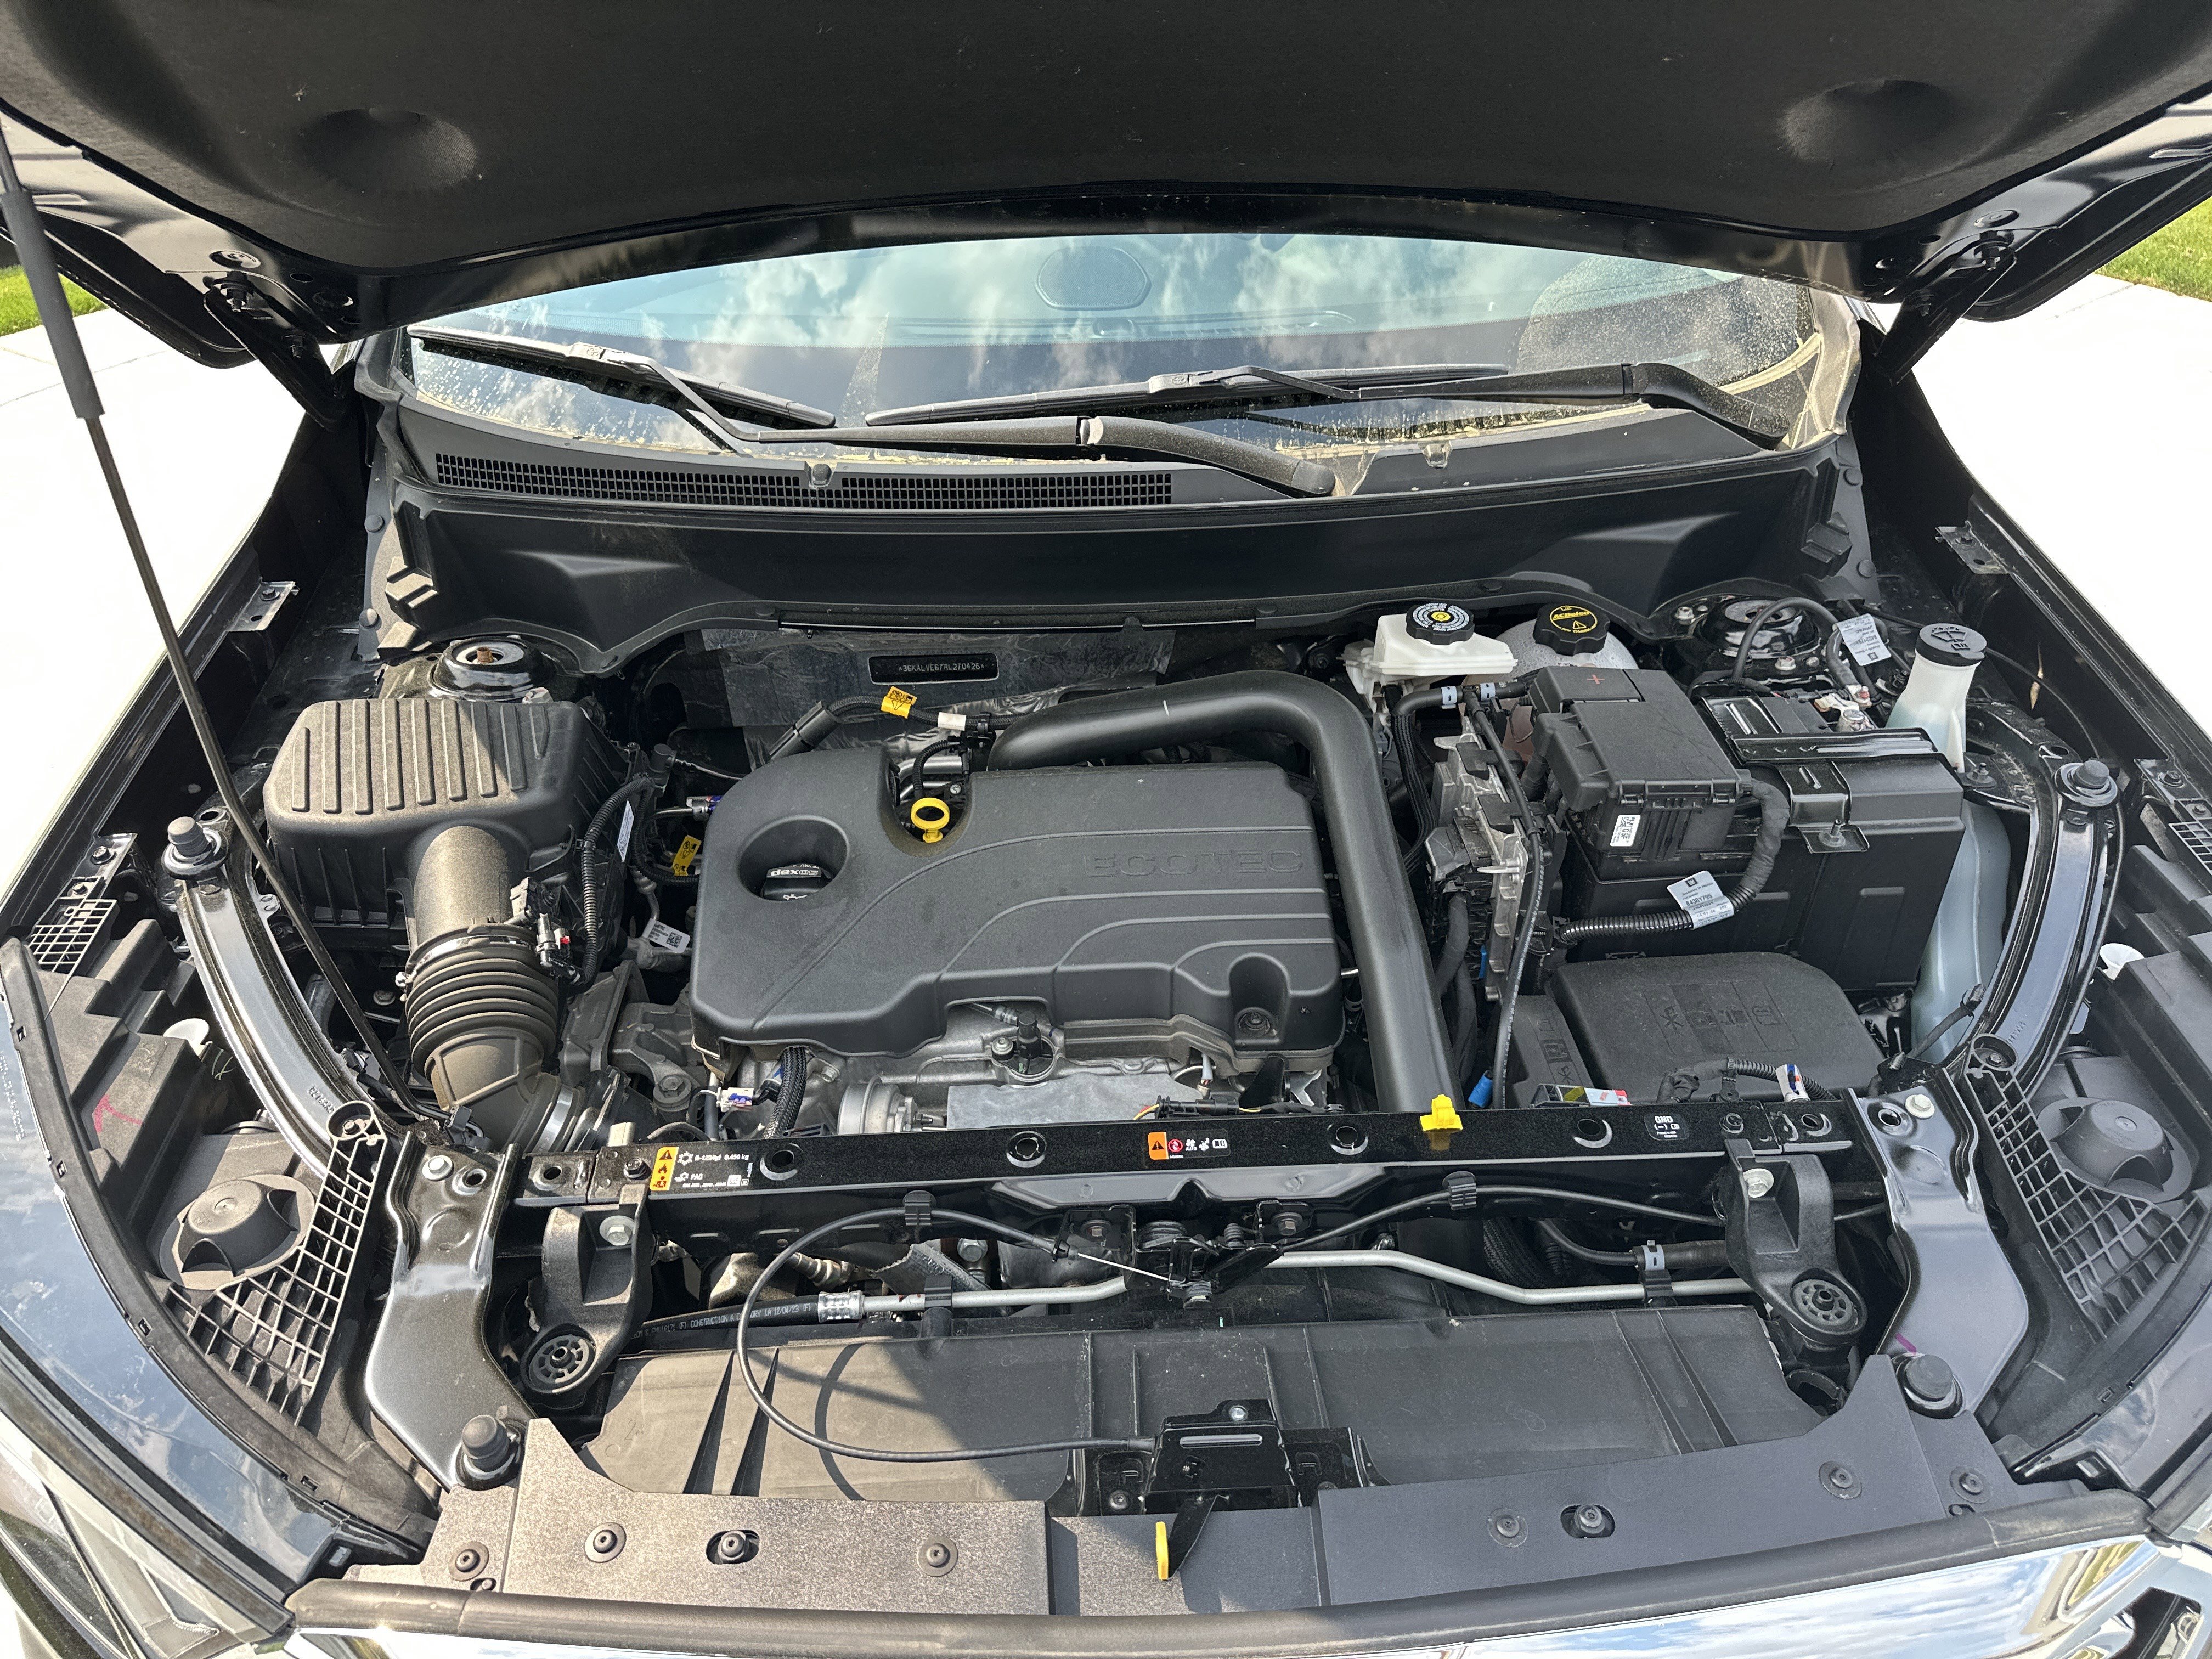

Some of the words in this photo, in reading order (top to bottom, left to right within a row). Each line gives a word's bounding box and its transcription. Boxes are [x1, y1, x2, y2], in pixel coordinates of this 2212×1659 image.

[1084, 849, 1304, 878] ECOTEC
[1655, 1115, 1673, 1124] GND
[690, 1315, 728, 1328] CONSTRUCTION
[774, 1304, 799, 1316] 12/04/23
